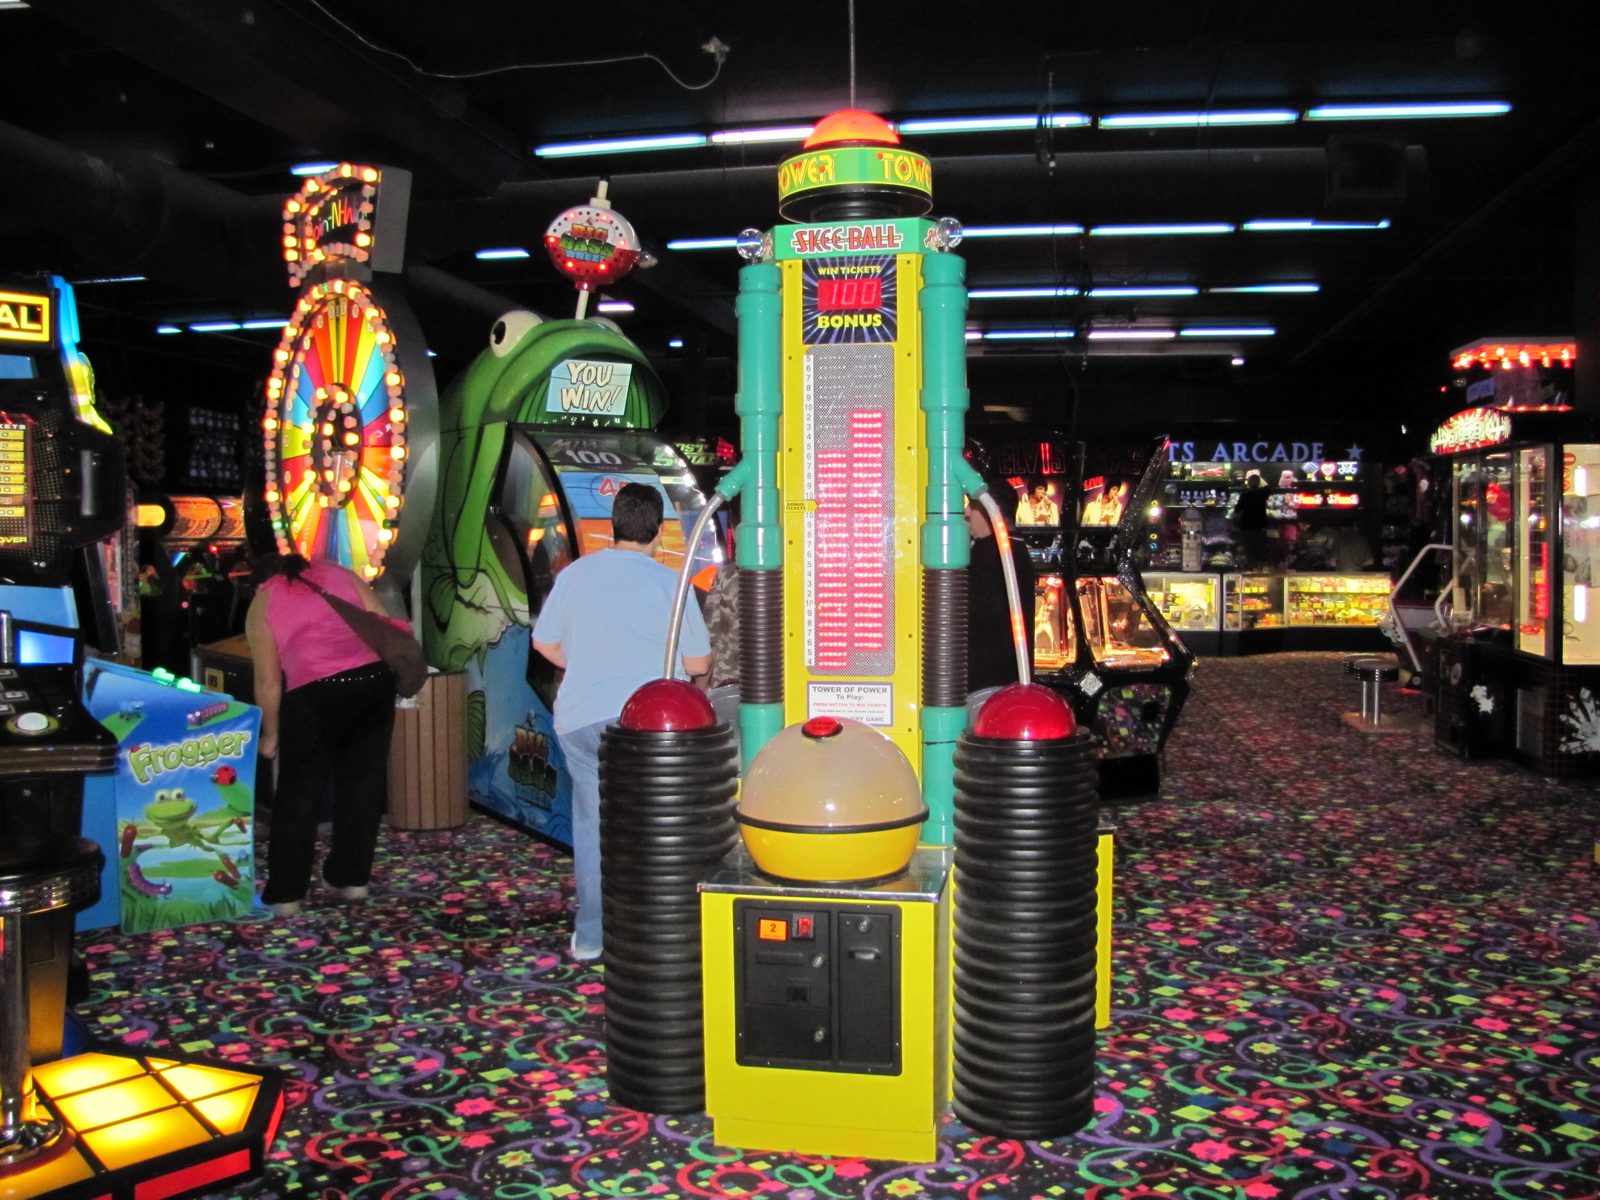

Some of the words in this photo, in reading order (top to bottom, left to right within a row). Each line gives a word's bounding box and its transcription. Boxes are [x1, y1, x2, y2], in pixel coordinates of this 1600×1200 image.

[778, 154, 835, 192] OWER
[818, 267, 838, 276] WIN
[839, 265, 882, 275] TICKETS
[830, 281, 878, 306] 100
[0, 304, 42, 330] AL
[817, 314, 883, 329] BONUS
[567, 362, 613, 387] YOU
[561, 384, 623, 412] WIN!
[566, 450, 622, 465] 100
[1211, 442, 1325, 462] ARCADE
[857, 686, 888, 694] POWER
[129, 731, 251, 784] Frogger
[770, 923, 777, 933] 2
